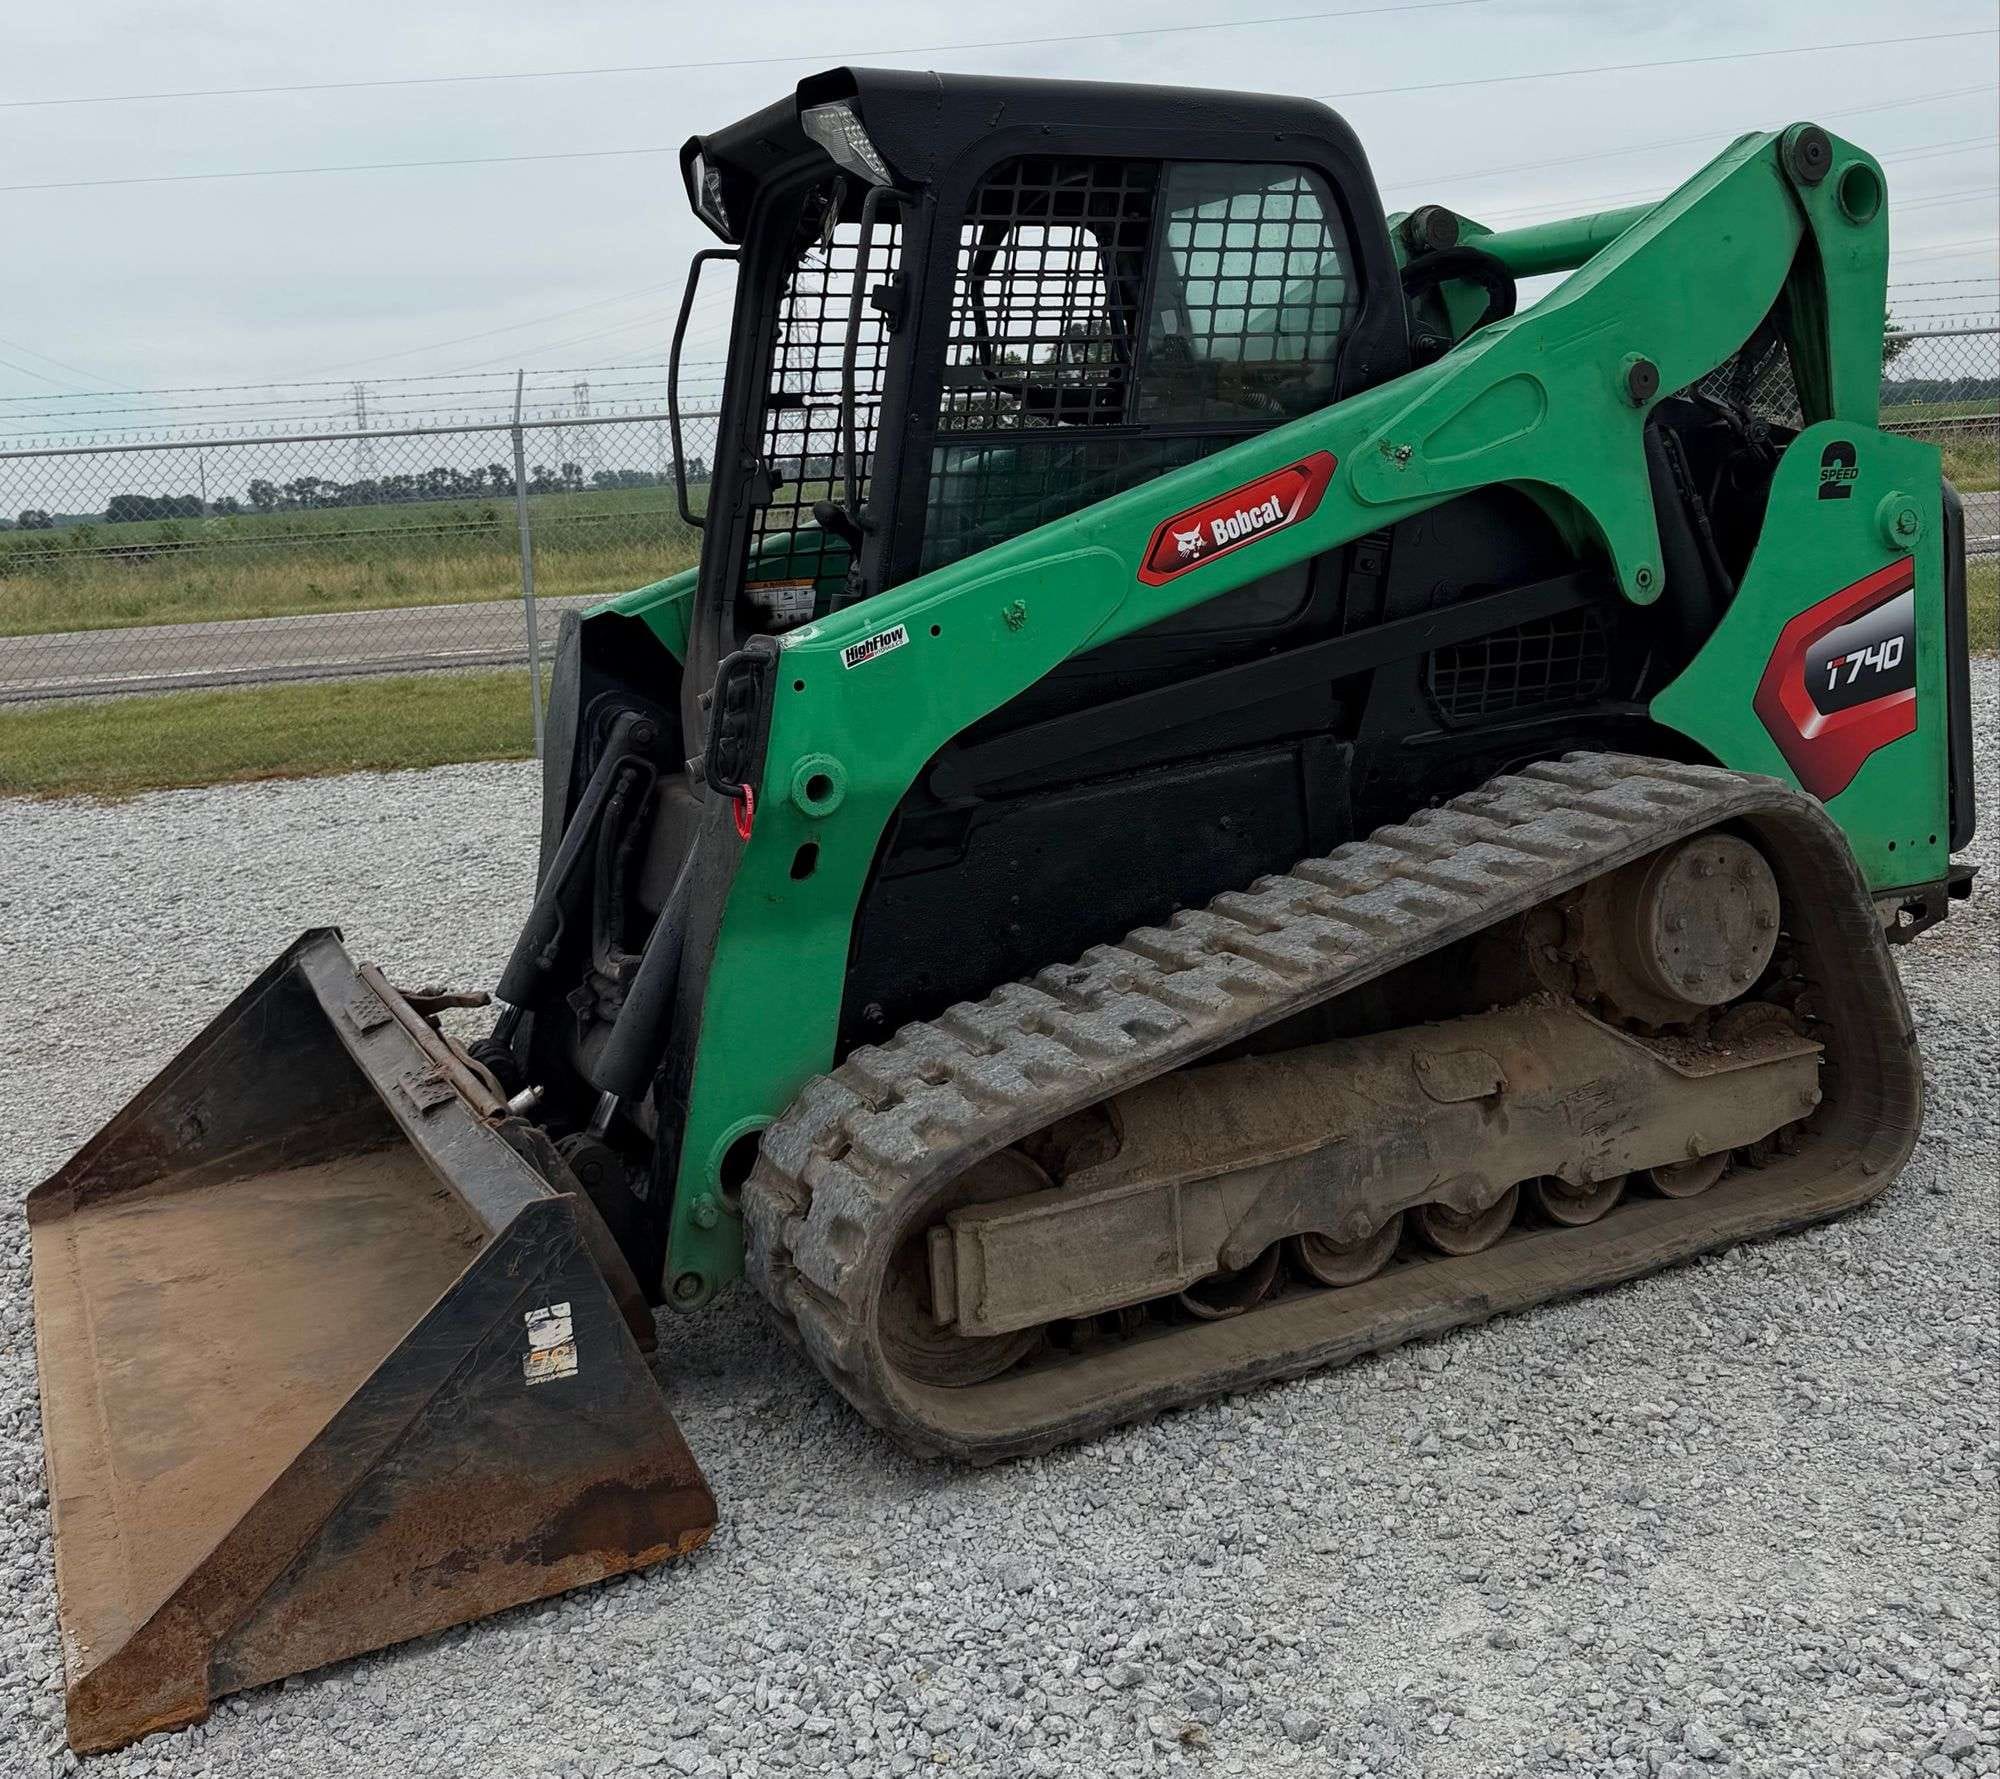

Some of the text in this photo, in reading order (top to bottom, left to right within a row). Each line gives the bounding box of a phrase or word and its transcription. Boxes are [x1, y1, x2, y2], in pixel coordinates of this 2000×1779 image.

[1818, 440, 1857, 500] 2
[1820, 467, 1859, 481] SPEED
[1210, 495, 1284, 546] Bobcat
[845, 627, 904, 663] HighFlow
[1826, 635, 1905, 691] T740
